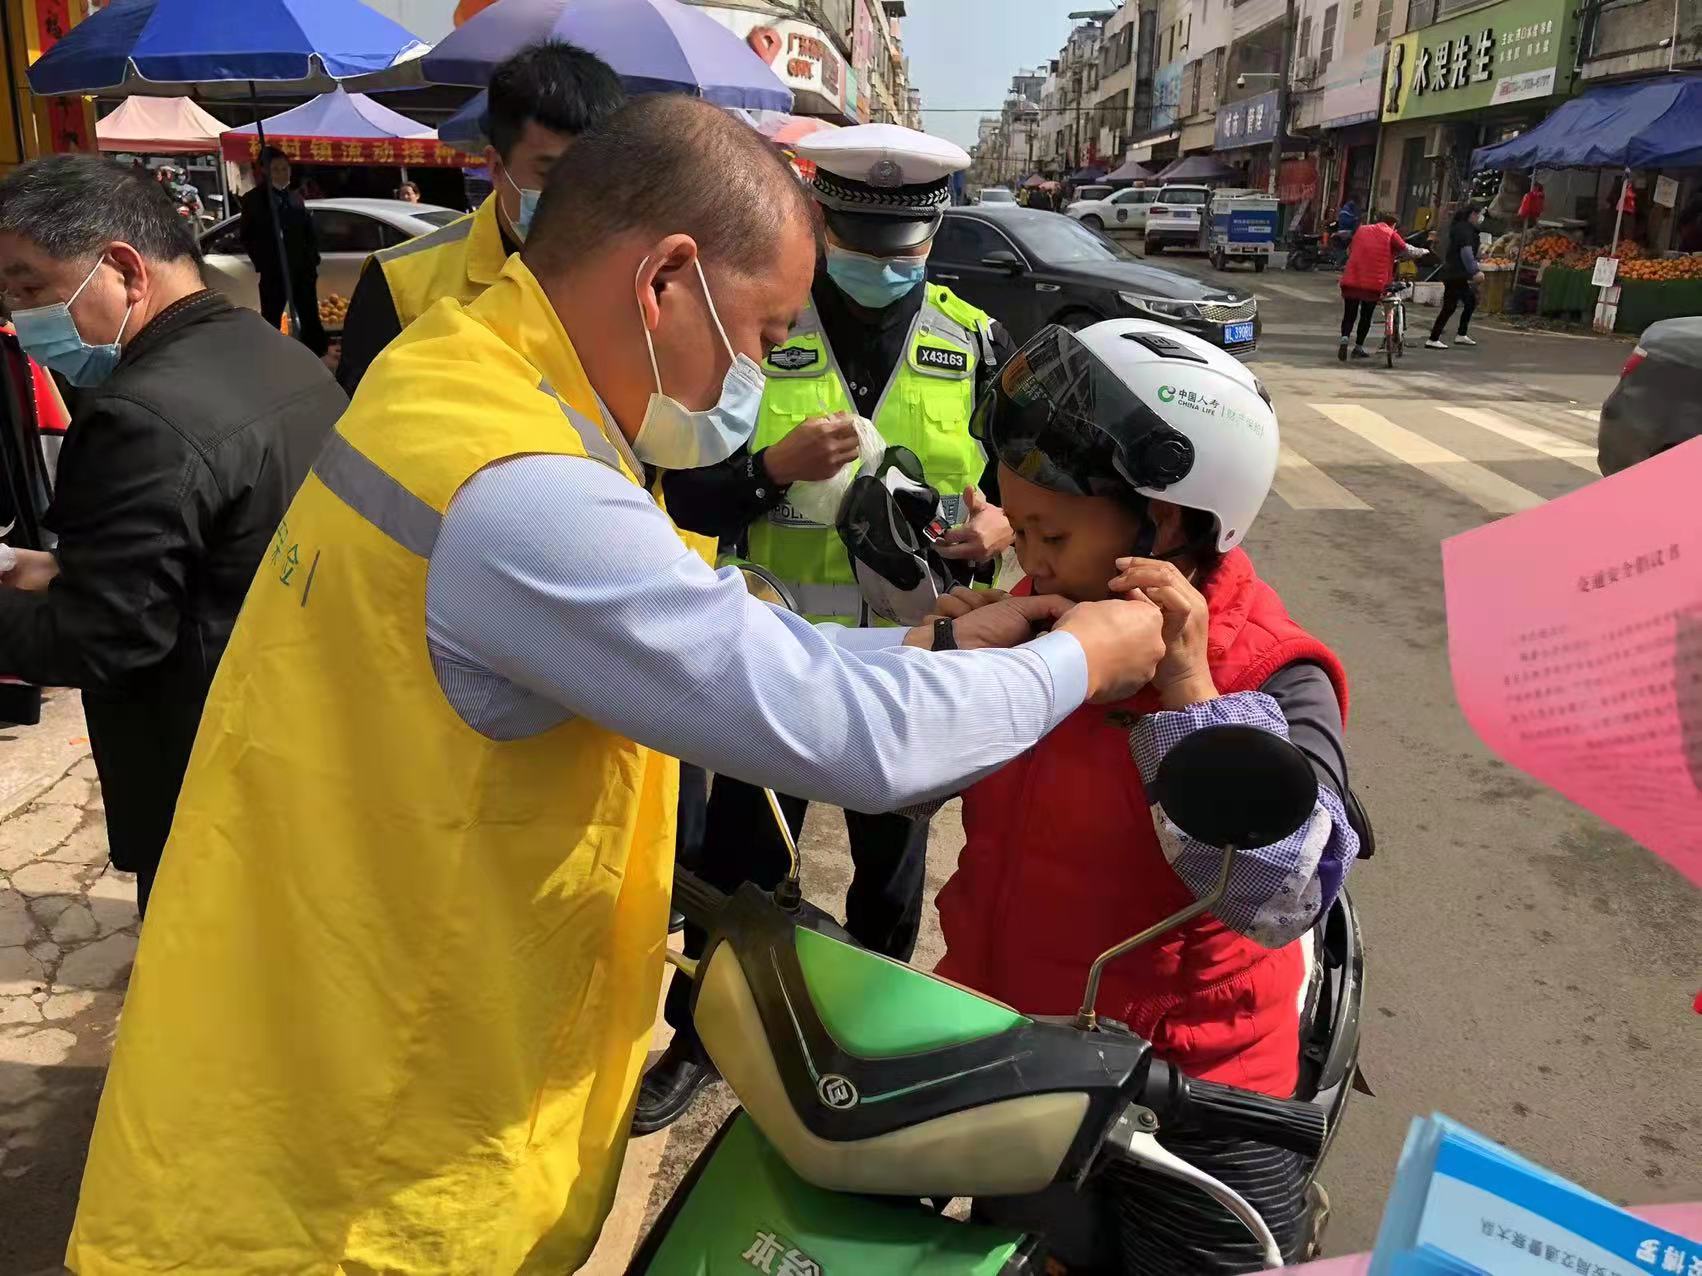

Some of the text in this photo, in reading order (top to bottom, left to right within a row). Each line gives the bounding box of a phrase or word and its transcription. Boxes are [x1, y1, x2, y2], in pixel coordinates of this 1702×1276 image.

[1413, 28, 1494, 96] 水果先生
[920, 349, 964, 367] X43163
[1177, 399, 1216, 417] CHINA LIFE
[1178, 389, 1220, 409] 中国人寿
